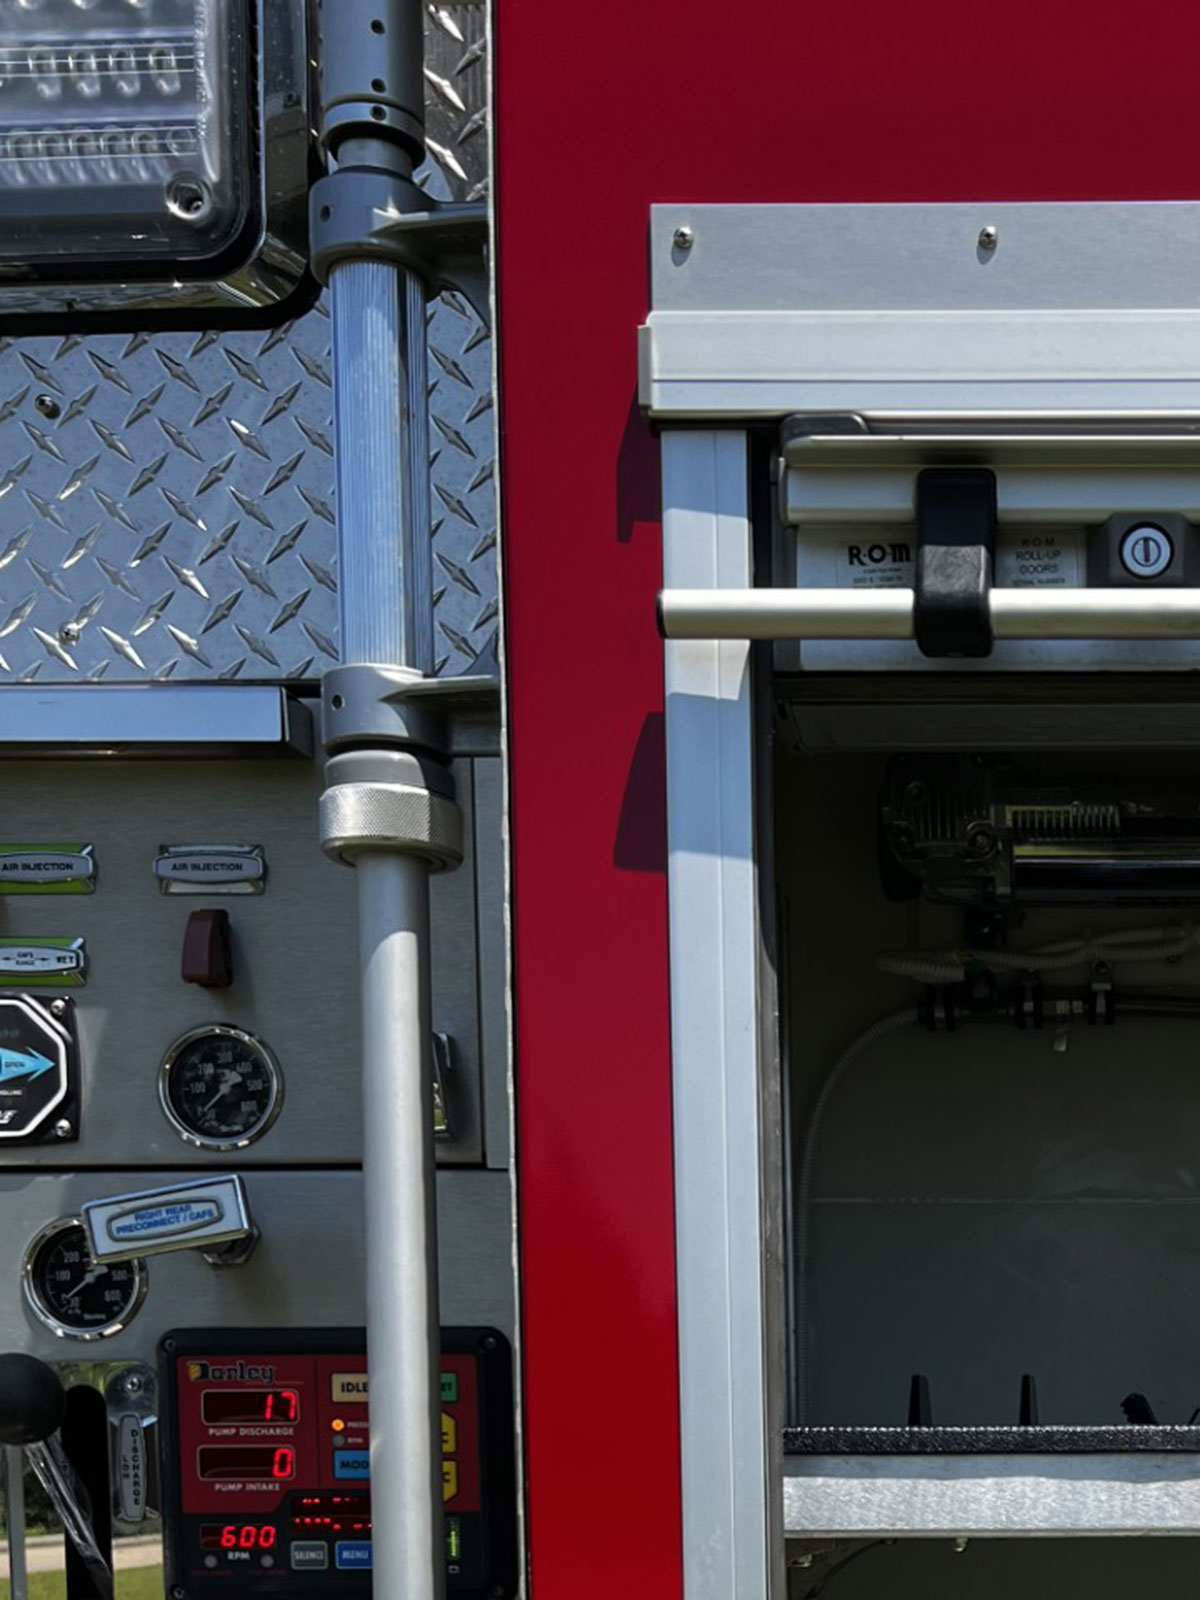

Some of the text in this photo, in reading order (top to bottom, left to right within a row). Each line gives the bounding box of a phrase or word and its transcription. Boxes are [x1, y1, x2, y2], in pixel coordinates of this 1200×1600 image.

[2, 862, 74, 871] AIR INJECTION
[171, 863, 243, 872] AIR INJECTION
[56, 955, 74, 965] WET
[116, 1215, 181, 1235] PRECONNECT
[63, 1252, 79, 1263] 200
[56, 1271, 71, 1281] 100
[111, 1270, 127, 1281] 500
[187, 1361, 276, 1383] Darley
[265, 1391, 298, 1420] 17
[208, 1427, 294, 1436] PUMP DISCHARGE
[131, 1428, 141, 1506] DISCHARGE
[272, 1448, 294, 1478] 0
[340, 1460, 369, 1470] MOD
[214, 1483, 281, 1492] PUMP INTAKE
[221, 1525, 276, 1548] 600
[227, 1551, 250, 1560] RPM
